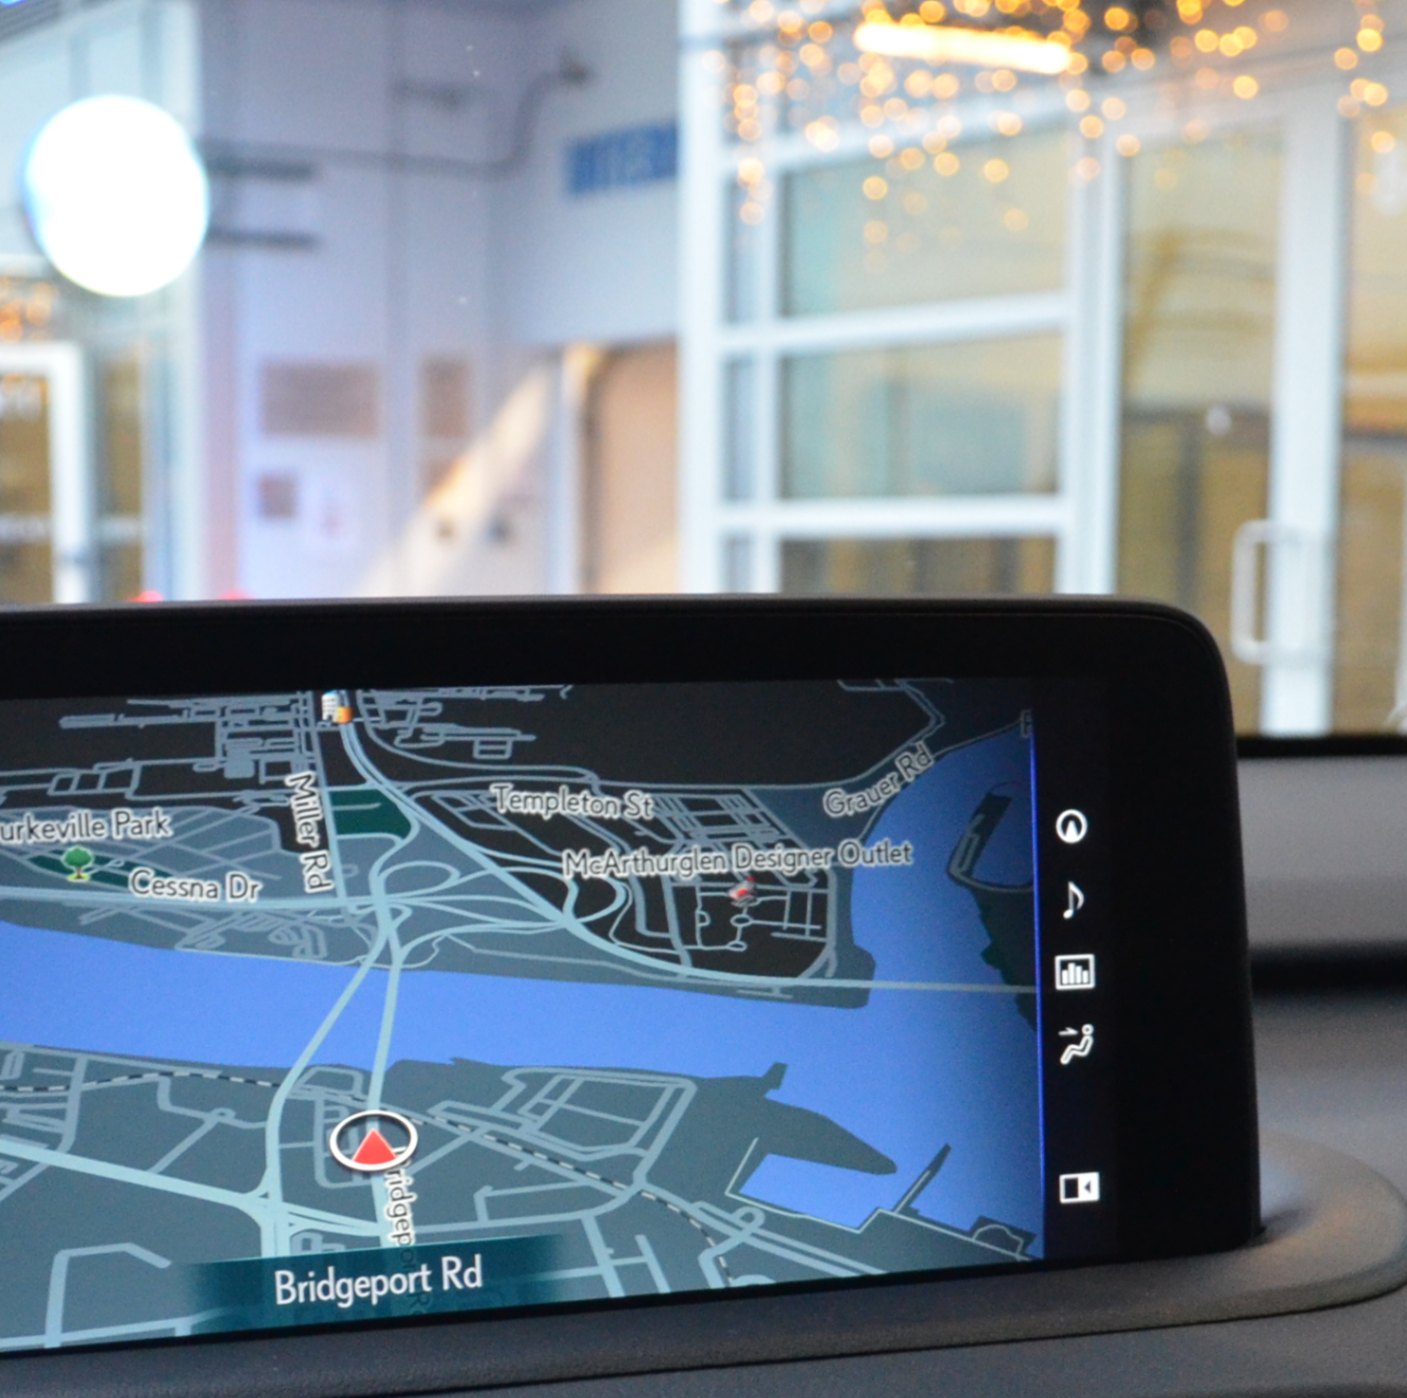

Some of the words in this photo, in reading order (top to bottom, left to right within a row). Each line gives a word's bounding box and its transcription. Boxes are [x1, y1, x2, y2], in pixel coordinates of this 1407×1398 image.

[822, 770, 901, 817] Grauer
[894, 742, 934, 779] Rd
[285, 771, 324, 848] Miller
[490, 783, 618, 820] Templeton
[623, 789, 654, 820] St
[113, 808, 173, 840] Park
[300, 849, 332, 894] Rd
[731, 841, 834, 873] Designer
[837, 838, 914, 869] Outlet
[128, 868, 219, 902] Cessna
[225, 874, 262, 903] Dr
[275, 1265, 432, 1308] Bridgeport
[441, 1253, 483, 1291] Rd
